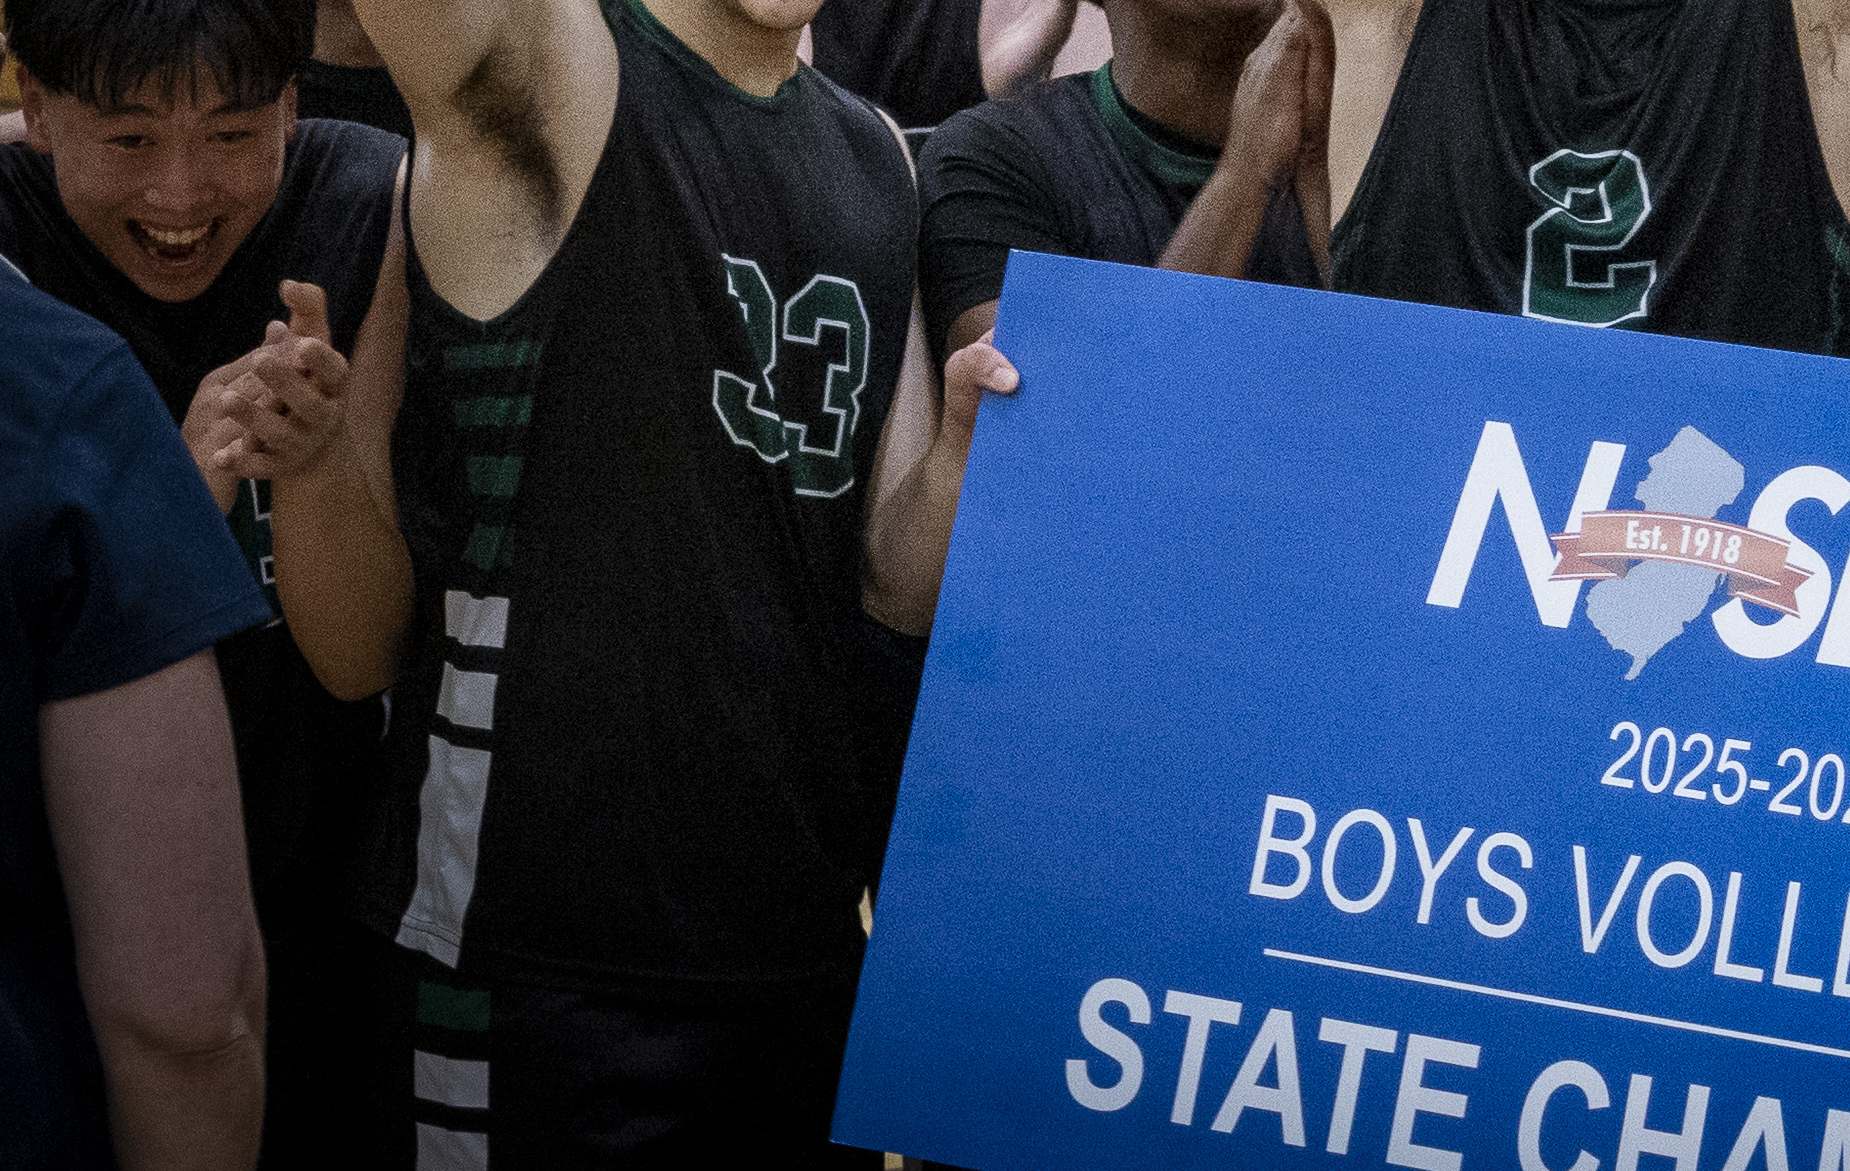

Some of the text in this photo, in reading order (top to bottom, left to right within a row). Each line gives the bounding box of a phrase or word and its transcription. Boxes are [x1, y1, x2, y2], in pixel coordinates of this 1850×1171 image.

[1521, 148, 1657, 328] 2
[1625, 519, 1743, 565] Est. 1918
[1248, 794, 1531, 939] BOYS
[1065, 977, 1482, 1171] STATE
